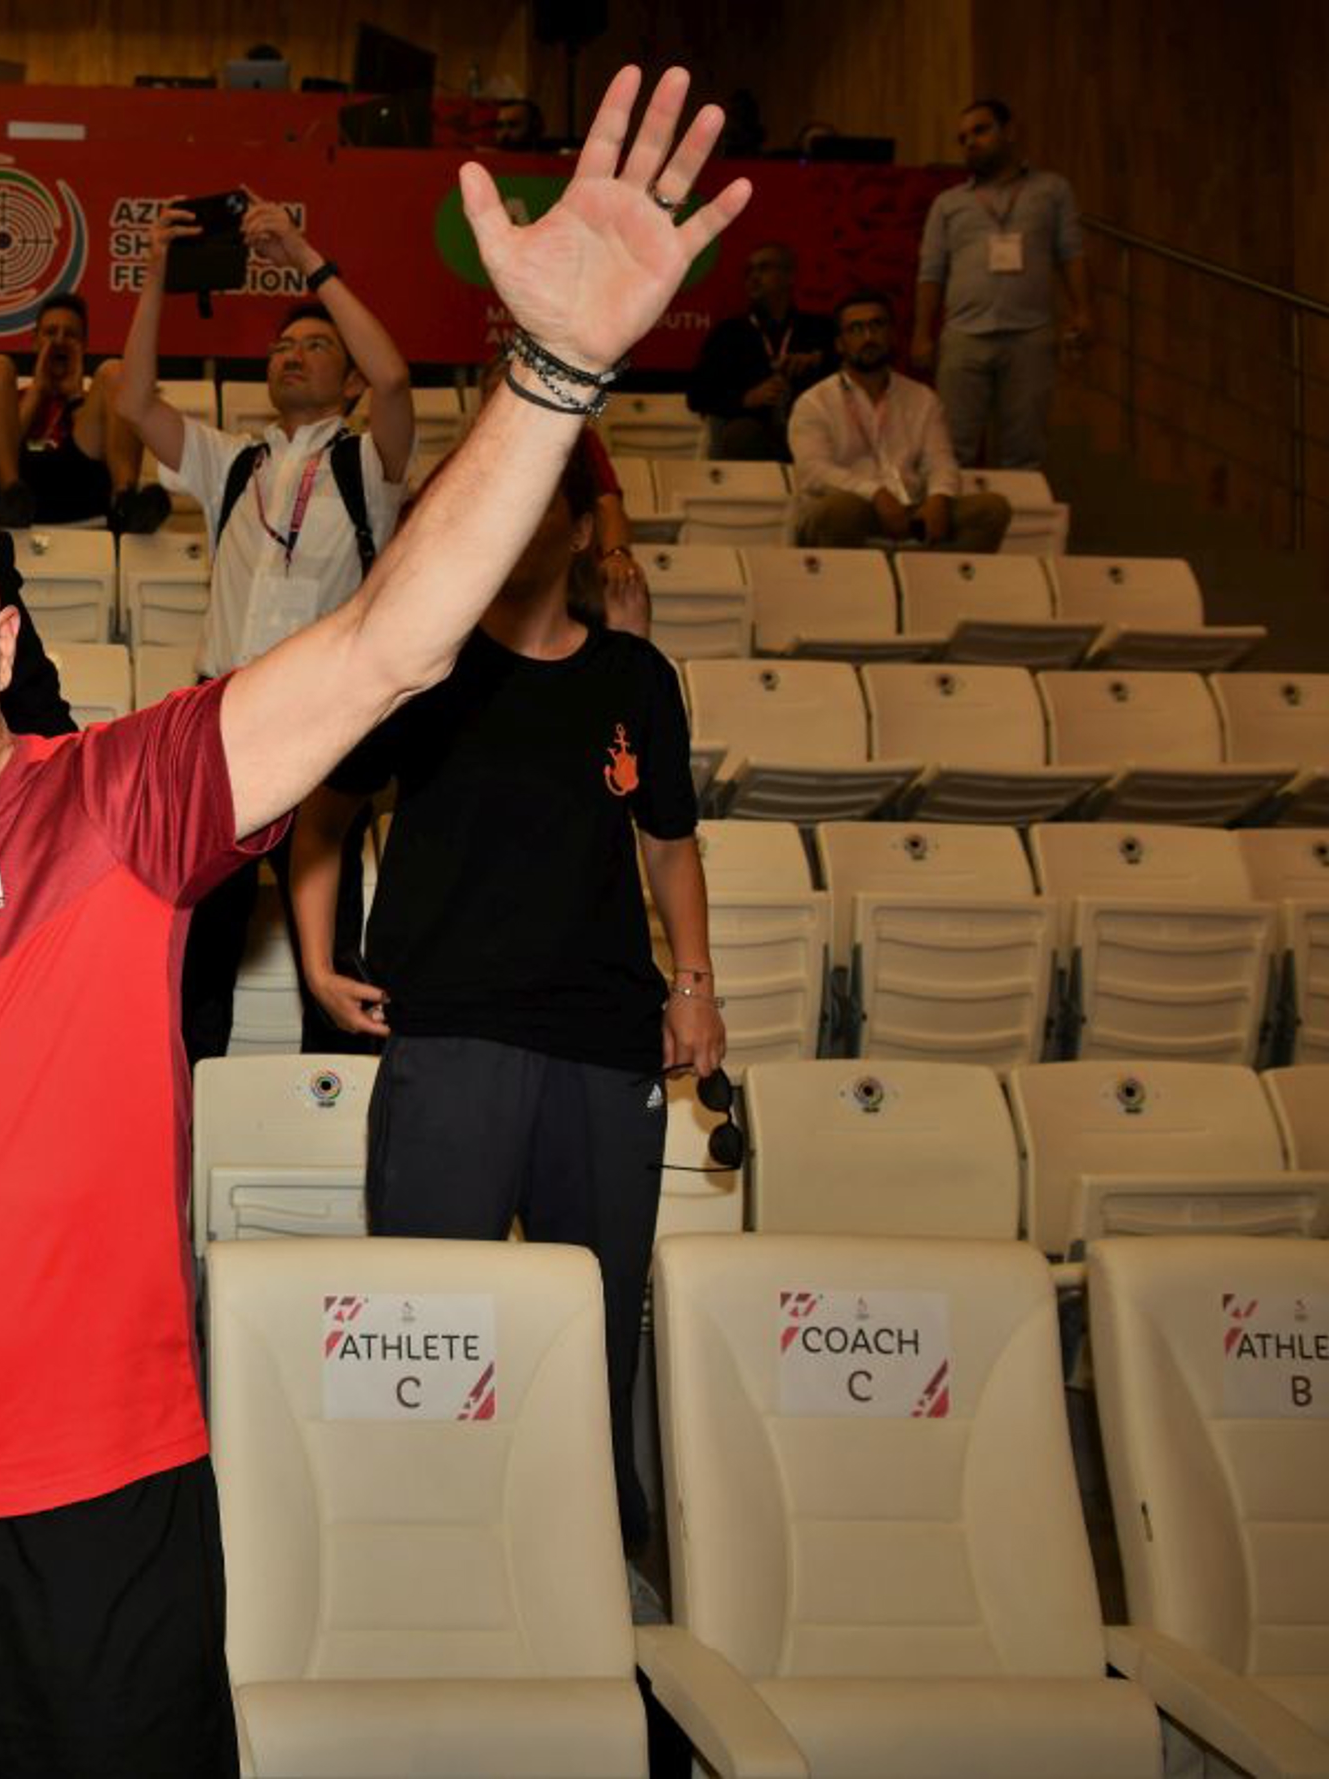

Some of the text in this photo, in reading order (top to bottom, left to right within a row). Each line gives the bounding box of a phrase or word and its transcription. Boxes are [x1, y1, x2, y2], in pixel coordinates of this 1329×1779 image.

[339, 1334, 480, 1361] ATHLETE
[802, 1326, 919, 1354] COACH
[1237, 1333, 1329, 1359] ATHLE
[396, 1376, 421, 1409] C
[848, 1370, 873, 1402] C
[1292, 1375, 1313, 1407] B
